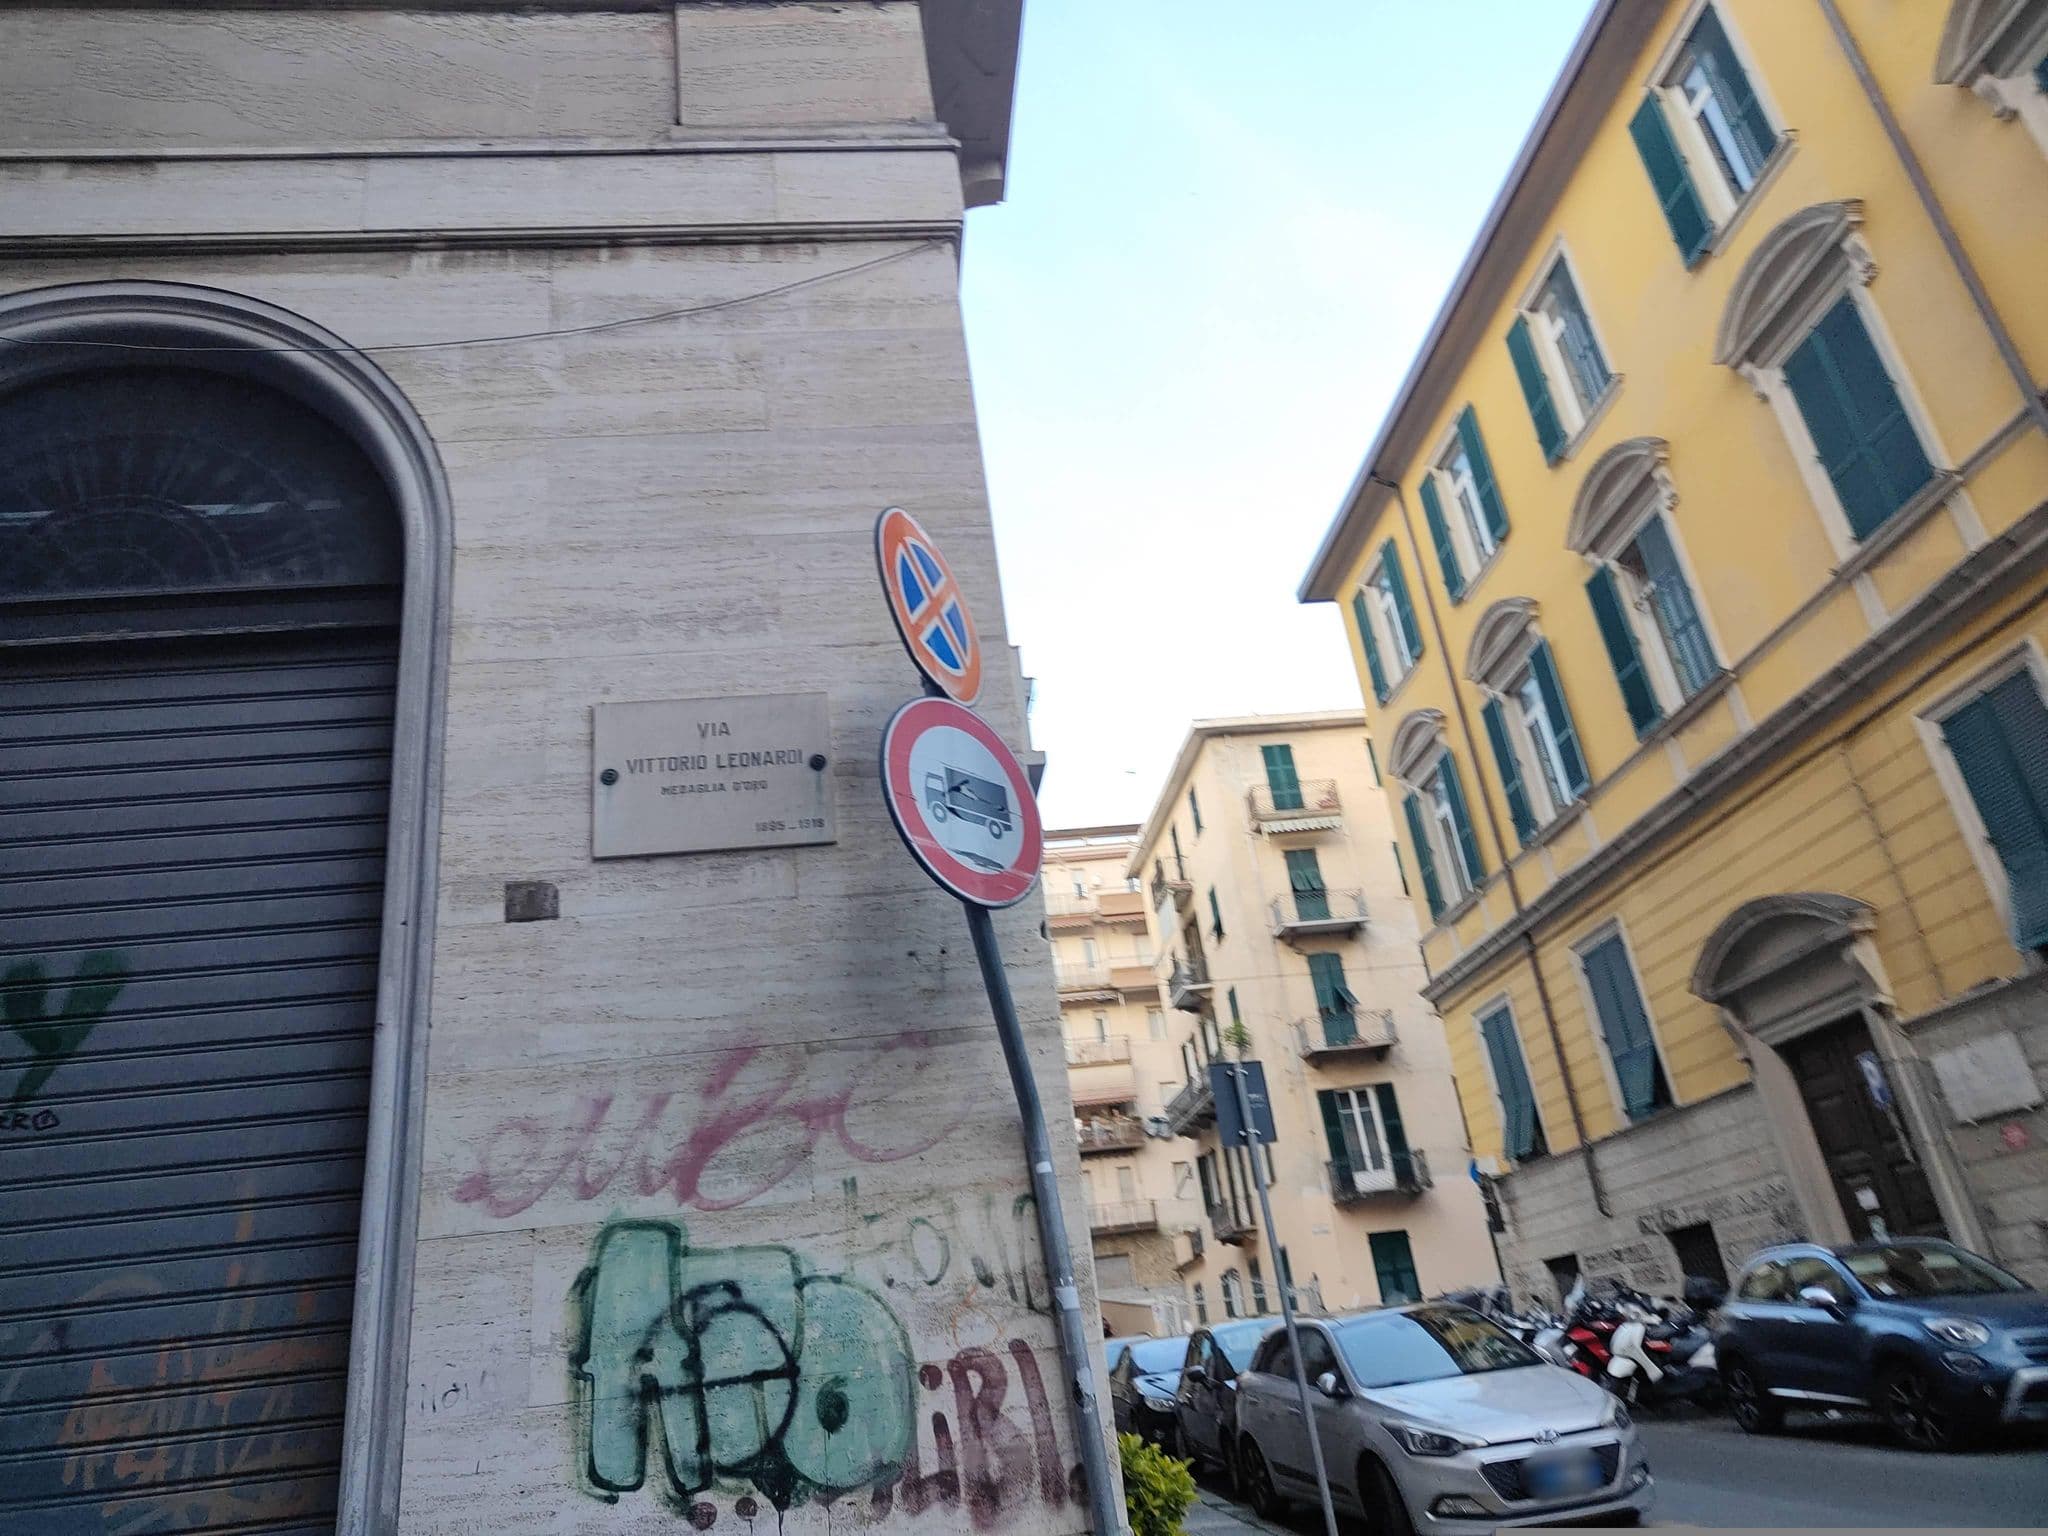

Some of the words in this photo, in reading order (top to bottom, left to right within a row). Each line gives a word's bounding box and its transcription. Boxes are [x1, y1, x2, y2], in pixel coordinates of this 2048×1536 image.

[697, 722, 731, 739] VIA
[626, 754, 707, 774] VITTORIO
[716, 749, 803, 769] LEONARDI
[661, 783, 726, 795] MEDAGLIA
[732, 780, 768, 792] D'ORO
